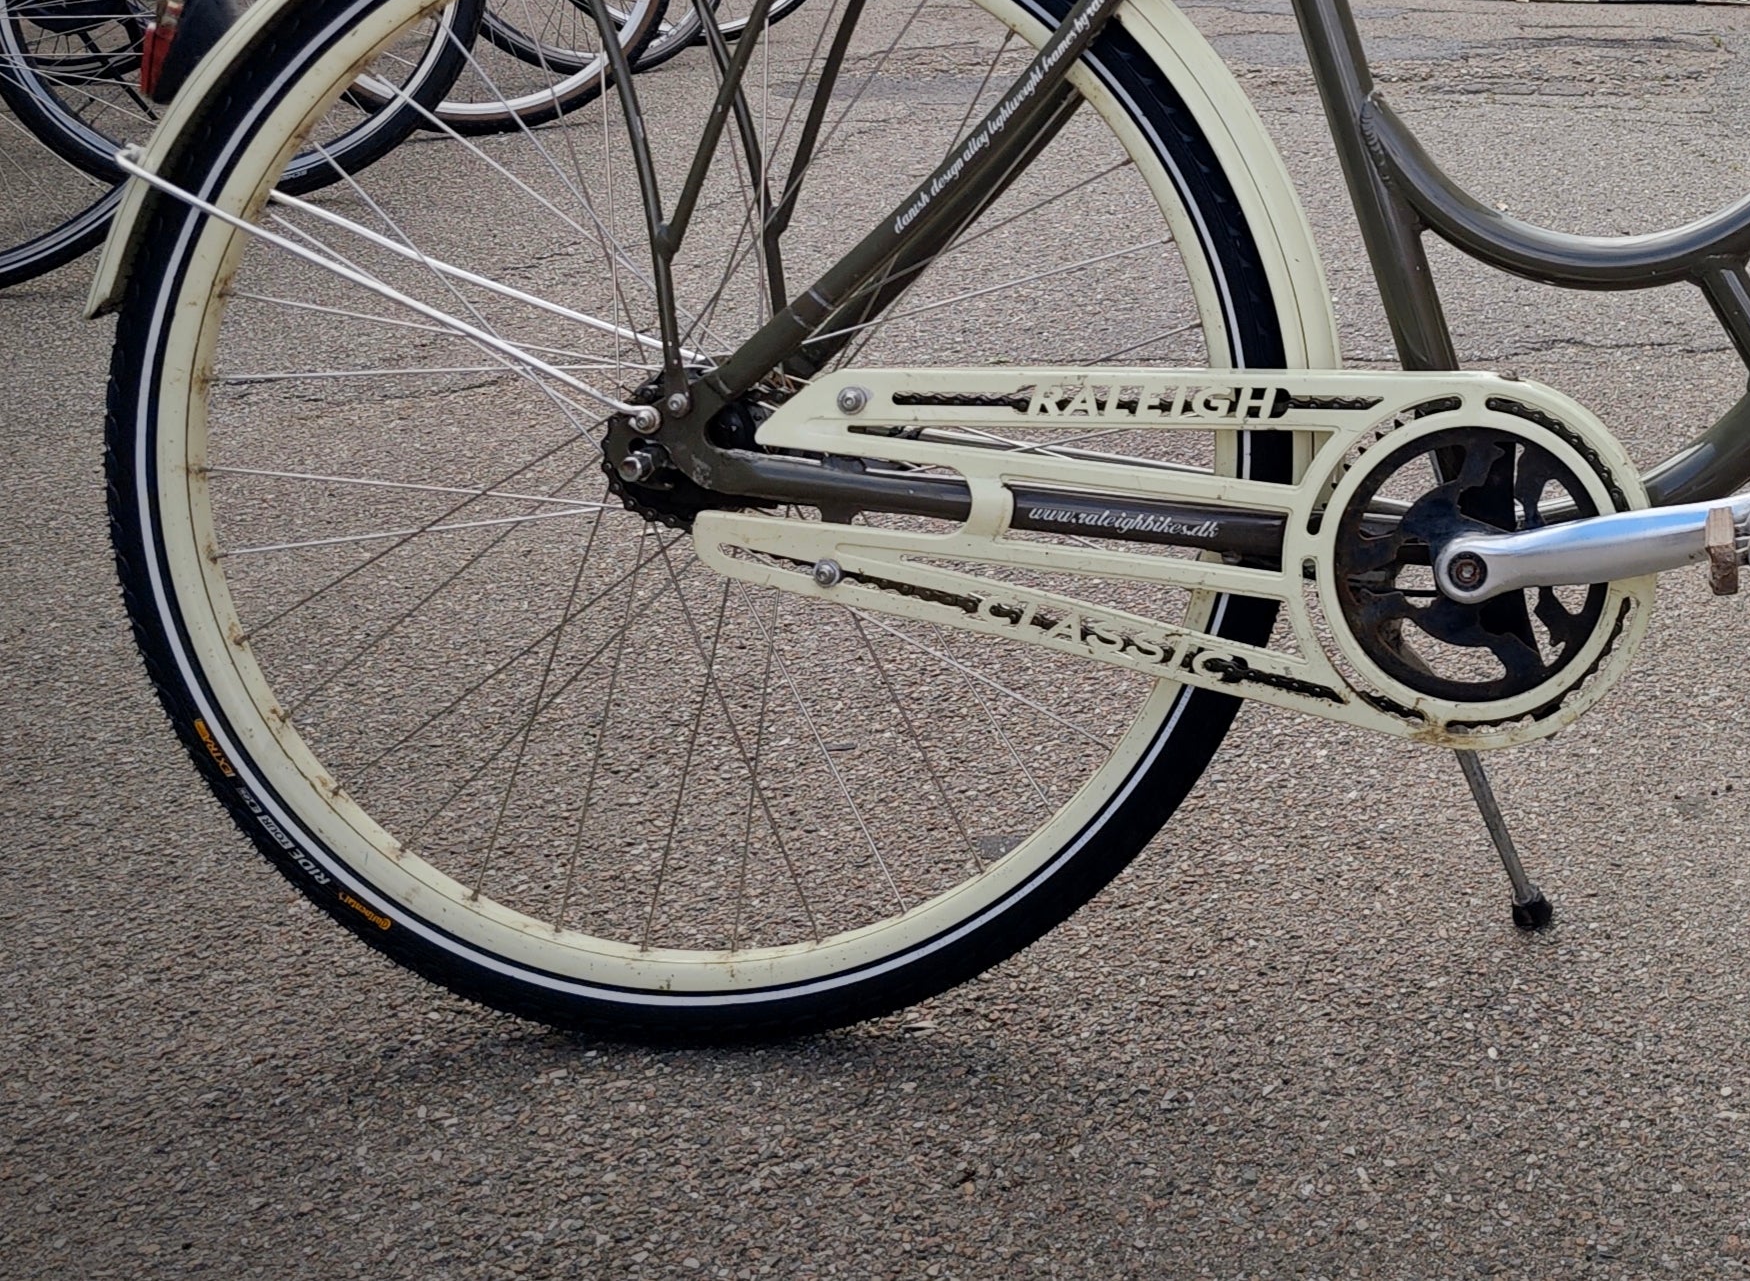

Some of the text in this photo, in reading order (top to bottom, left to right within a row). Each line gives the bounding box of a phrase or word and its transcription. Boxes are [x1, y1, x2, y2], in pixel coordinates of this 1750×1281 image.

[963, 130, 990, 162] alloy
[1073, 16, 1092, 34] by
[1026, 384, 1278, 419] RALEIGH
[1028, 506, 1220, 539] www.raleighbikes.dk
[978, 596, 1234, 675] CLASSIC
[261, 816, 295, 849] TOUR
[288, 848, 331, 885] RIDE
